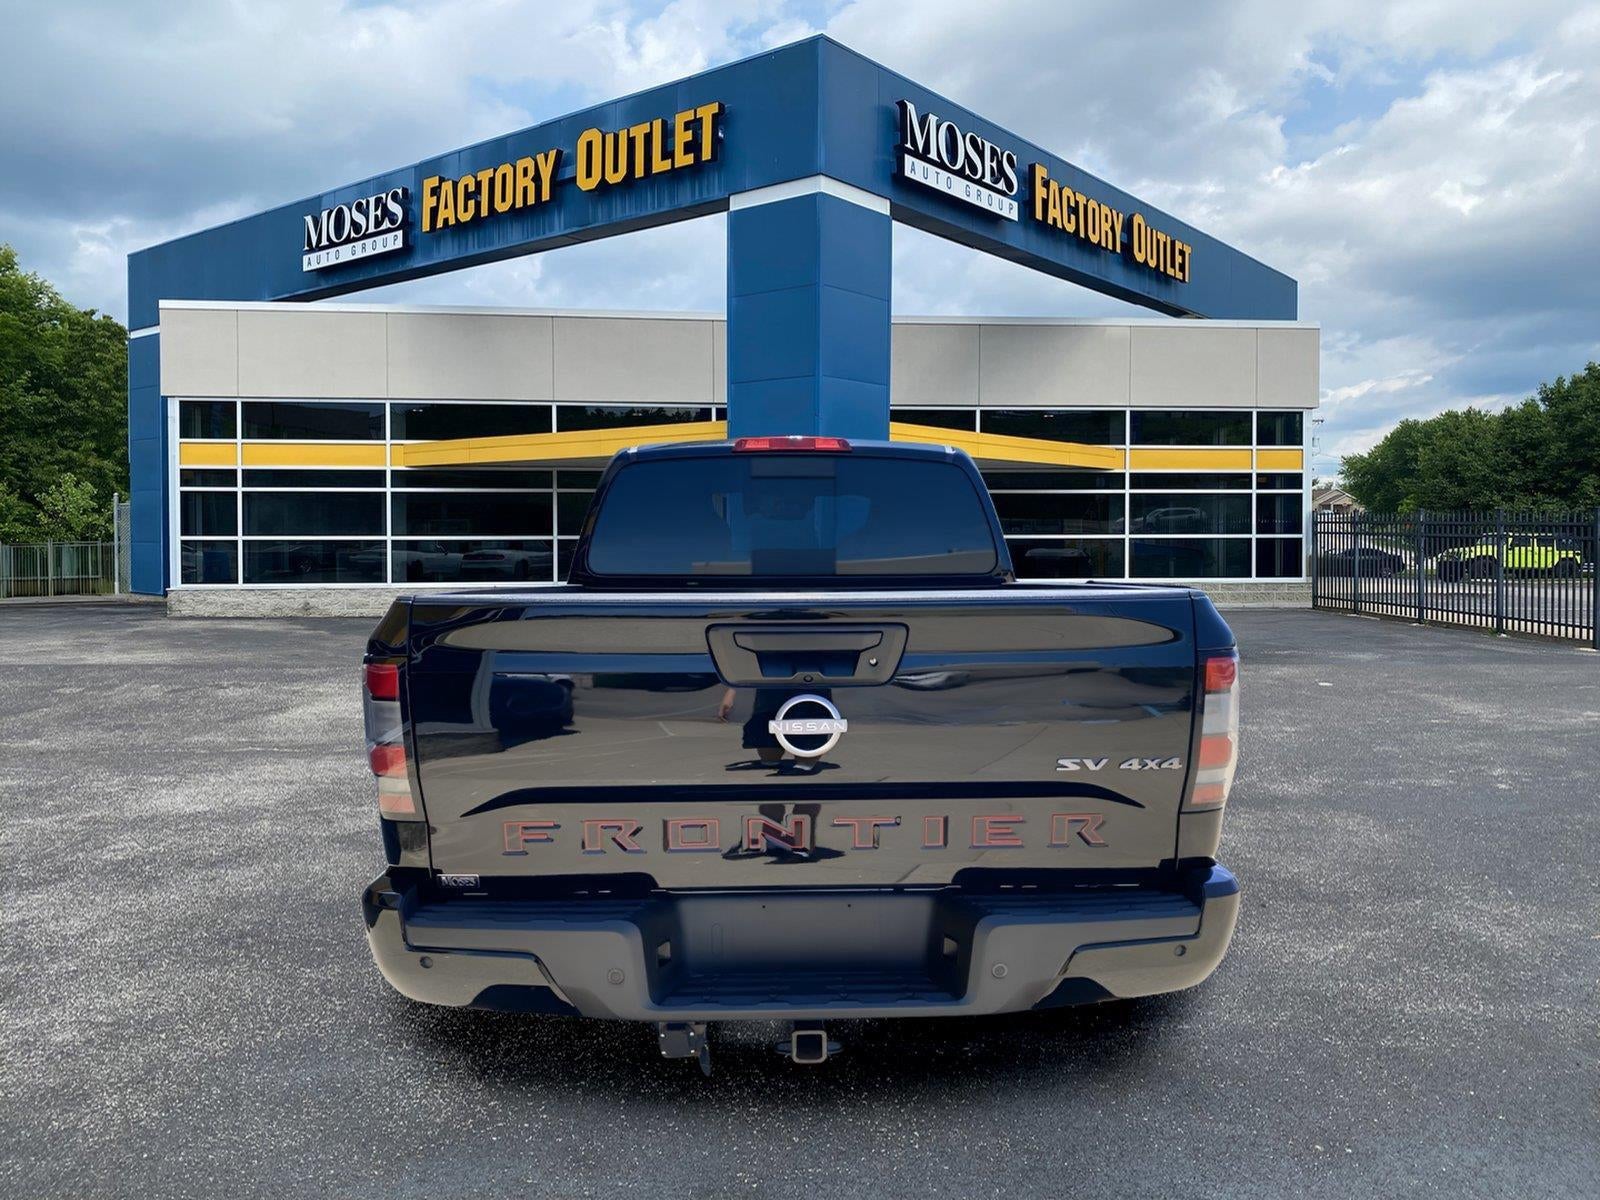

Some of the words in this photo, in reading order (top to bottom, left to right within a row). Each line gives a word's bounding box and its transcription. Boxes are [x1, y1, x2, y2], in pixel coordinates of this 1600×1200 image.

[903, 99, 1018, 196] MOSES
[909, 161, 953, 190] AUTO
[965, 185, 1015, 215] GROUP
[303, 187, 403, 250] MOSES
[306, 249, 341, 268] AUTO
[349, 233, 401, 256] GROUP
[769, 721, 845, 733] NISSAN
[1056, 757, 1109, 772] SV
[502, 813, 1108, 856] FRONTIER
